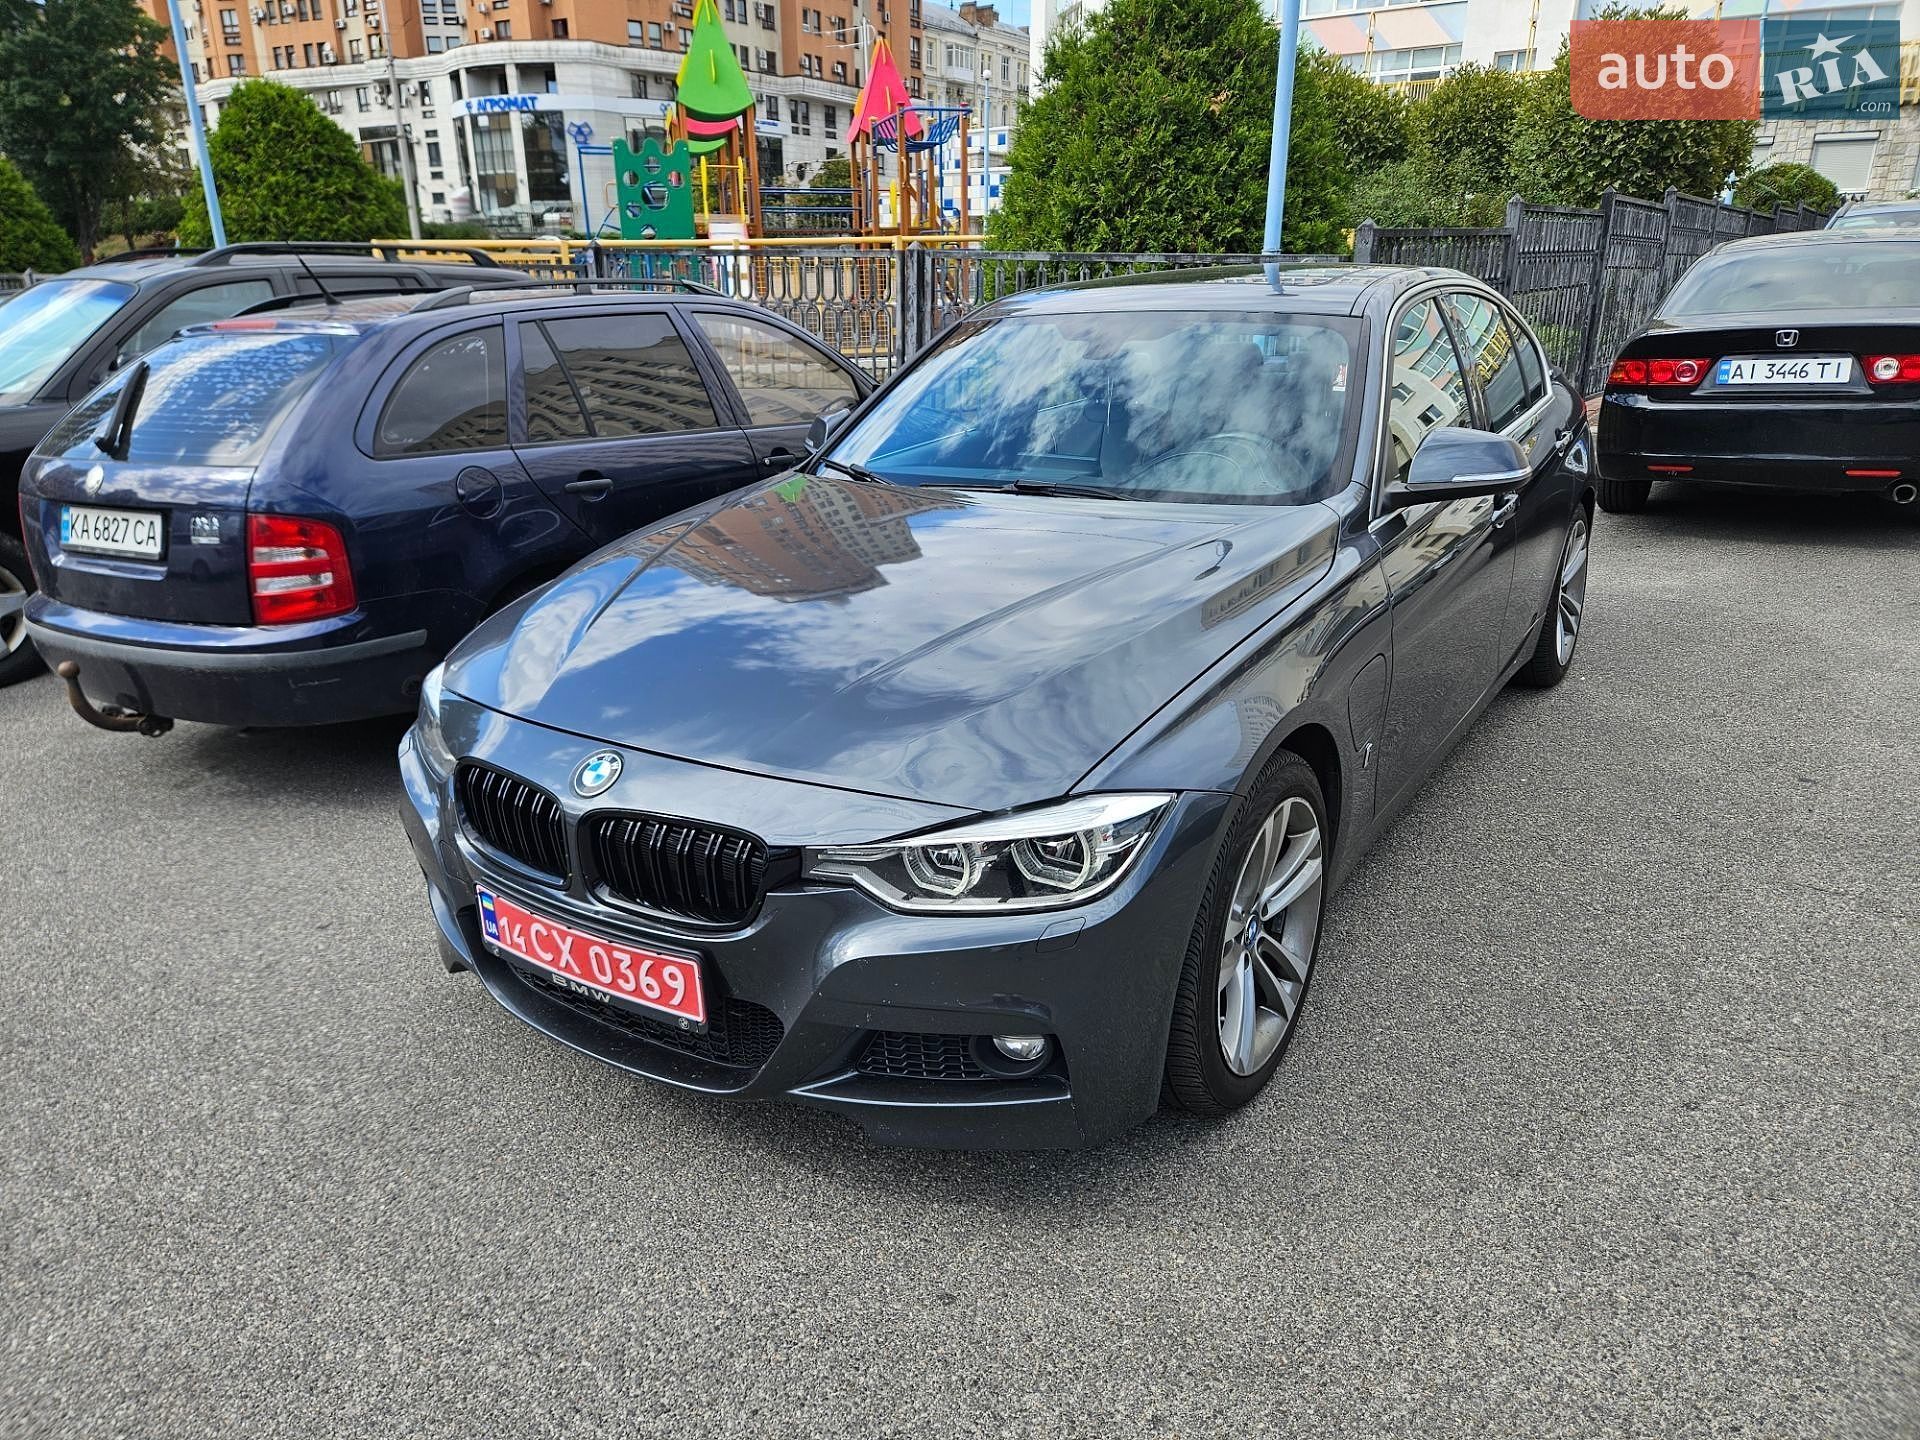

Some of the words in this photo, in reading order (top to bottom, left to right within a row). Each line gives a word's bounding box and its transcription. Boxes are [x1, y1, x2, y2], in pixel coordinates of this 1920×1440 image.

[1731, 363, 1756, 380] AI
[1764, 362, 1810, 379] 3446
[1817, 362, 1841, 379] TI
[70, 513, 90, 540] KA
[94, 516, 130, 544] 6827
[133, 519, 158, 547] CA
[485, 919, 499, 936] UA
[552, 973, 613, 1003] BMW
[588, 945, 686, 1006] 0369
